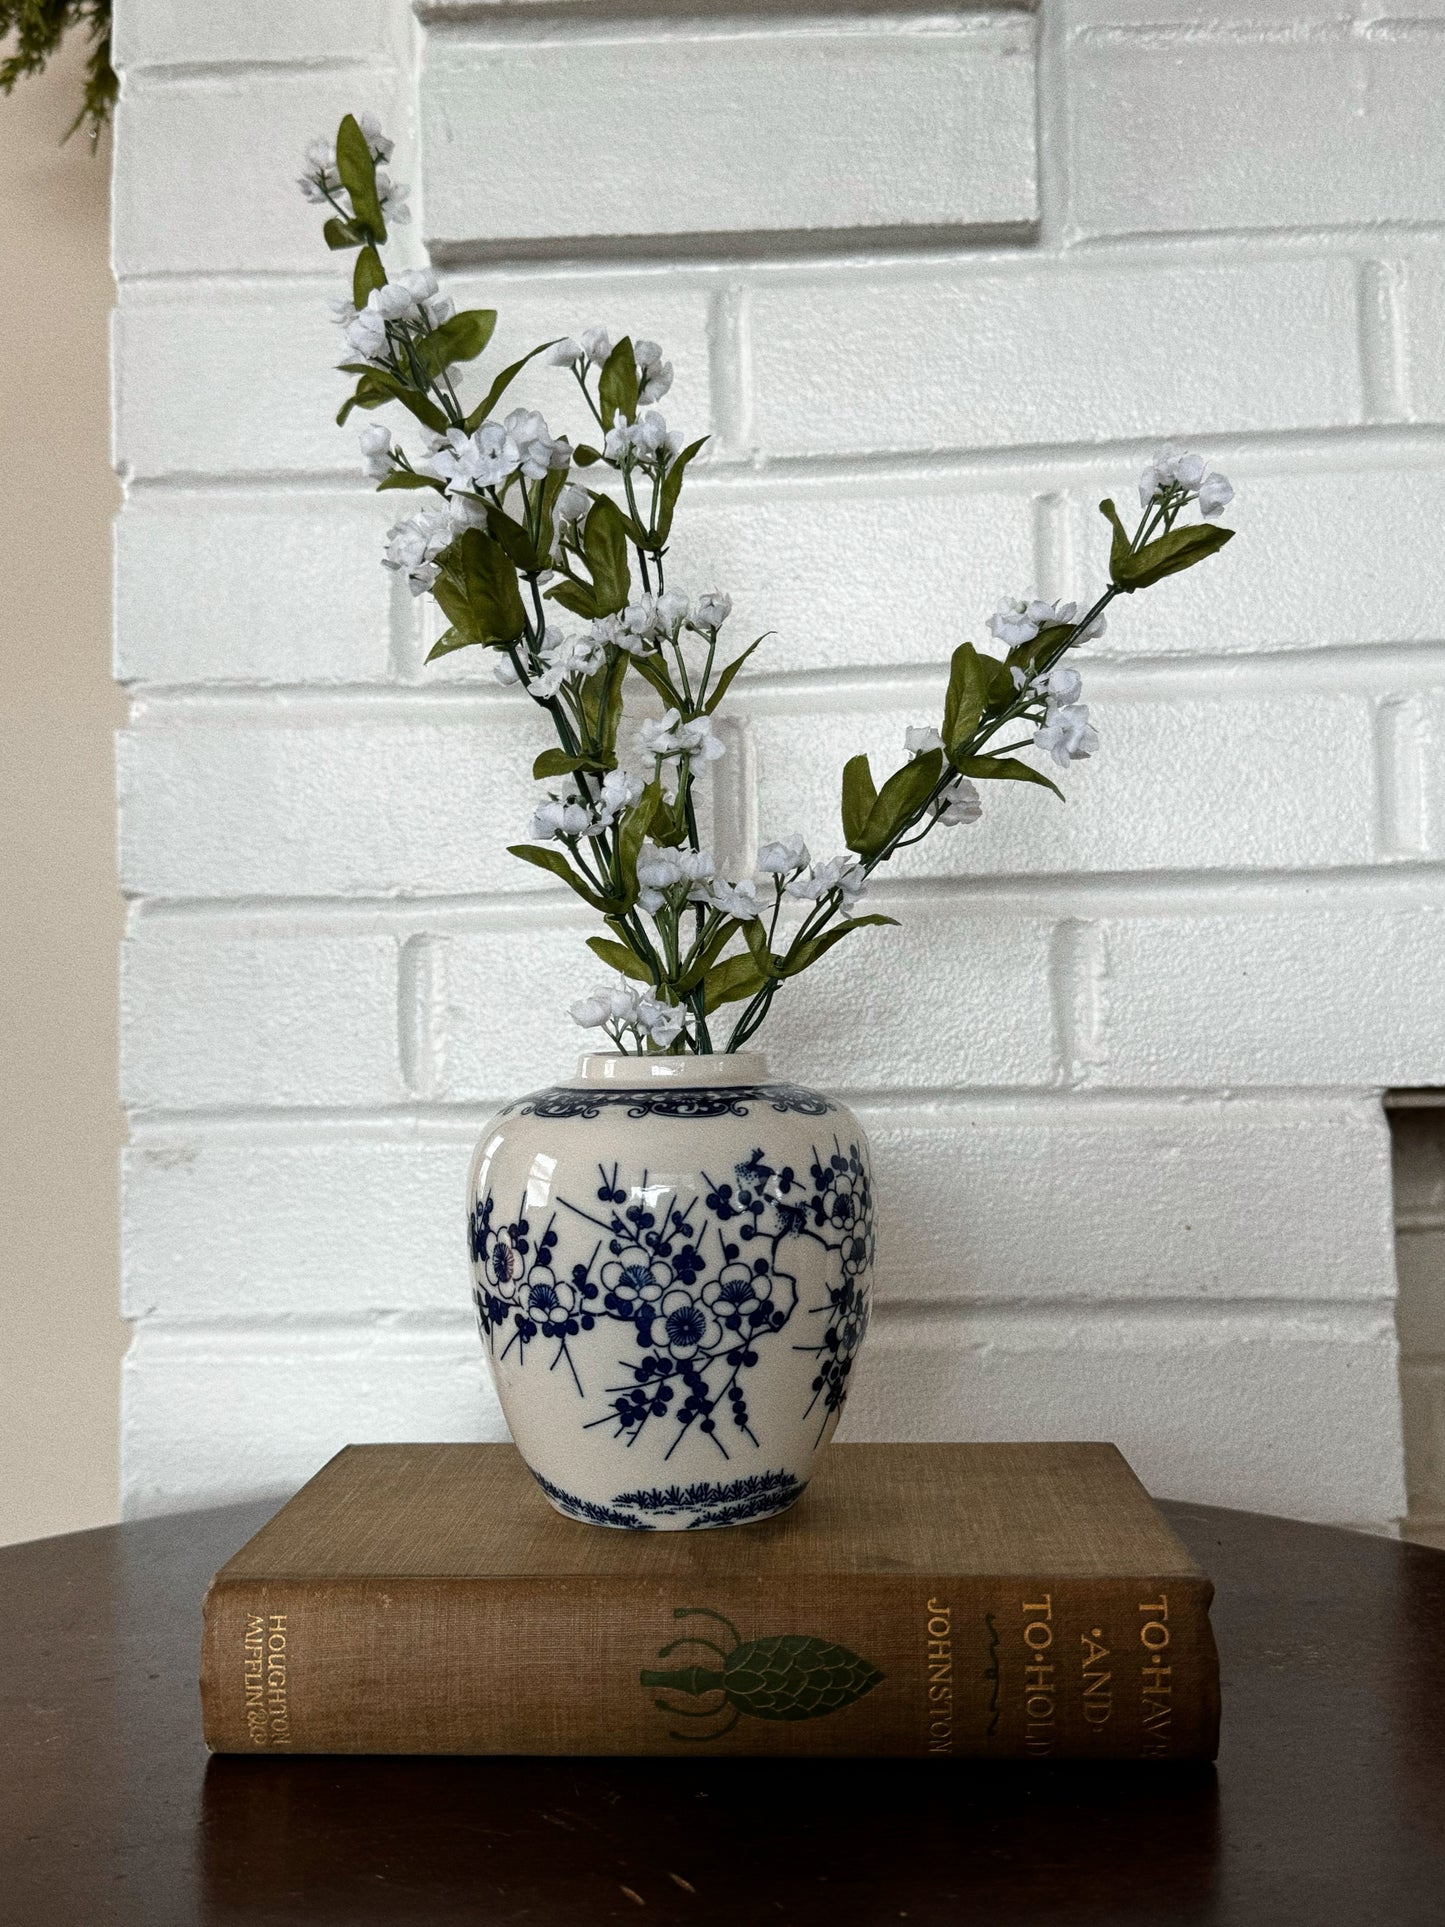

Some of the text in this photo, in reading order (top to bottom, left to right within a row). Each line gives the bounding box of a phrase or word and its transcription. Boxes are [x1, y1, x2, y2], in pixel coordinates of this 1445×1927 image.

[244, 1613, 264, 1706] MIFFLIN
[268, 1615, 291, 1744] HOUGHTON
[927, 1597, 952, 1753] JOHNSTON
